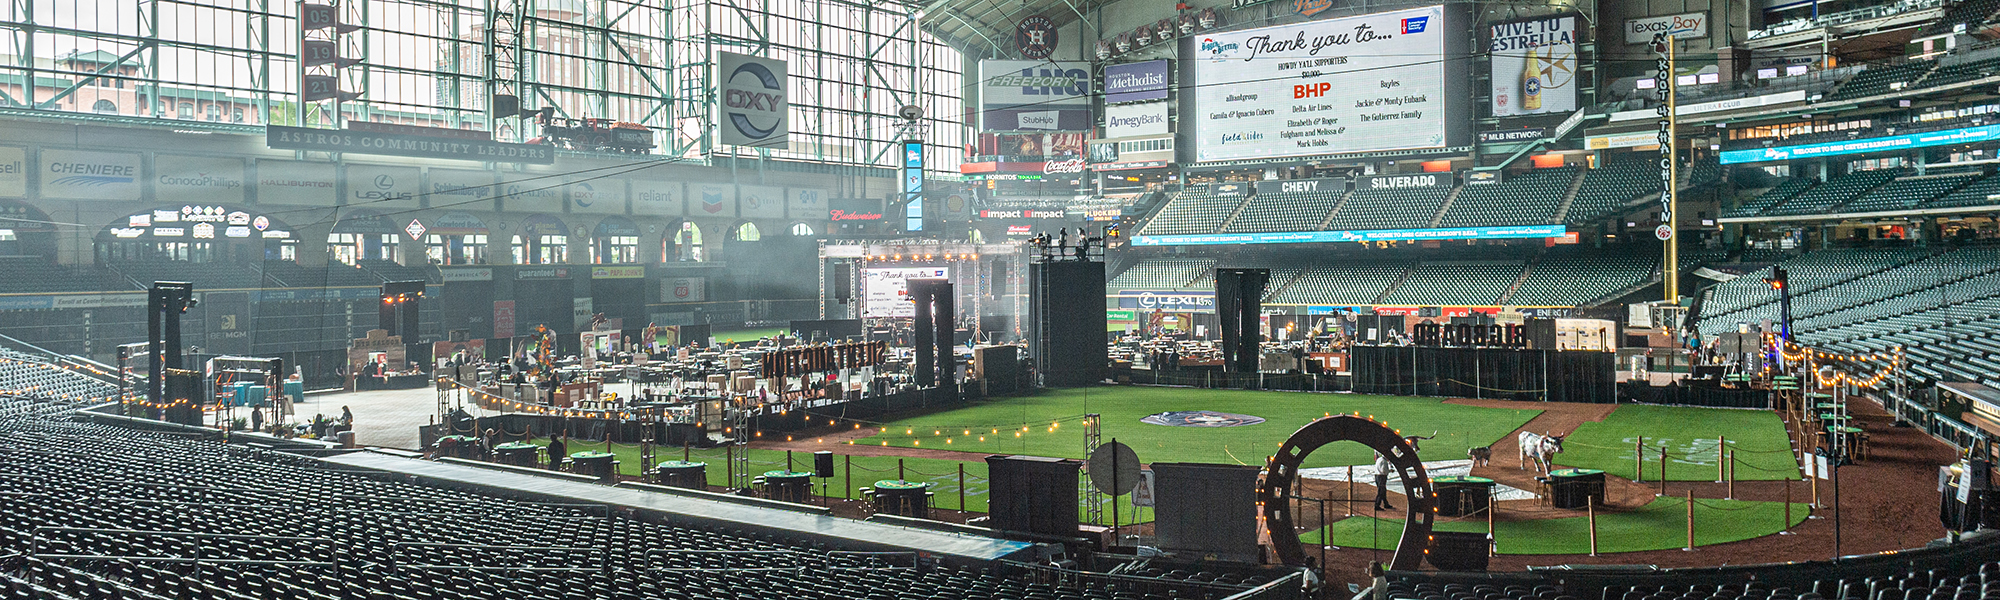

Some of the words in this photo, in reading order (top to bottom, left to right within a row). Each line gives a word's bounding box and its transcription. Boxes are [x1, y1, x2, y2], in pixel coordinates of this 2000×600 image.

[310, 10, 329, 23] 05
[1020, 16, 1053, 30] HOUSTON
[1540, 20, 1560, 33] TU
[1629, 20, 1668, 33] Texas
[1673, 16, 1702, 31] Bay
[1244, 30, 1308, 61] Thank
[1309, 33, 1350, 56] you
[1354, 23, 1393, 43] to...
[1491, 30, 1575, 51] ESTRELLA!
[312, 47, 330, 60] 19
[1022, 46, 1052, 58] ASTROS
[1277, 61, 1297, 70] HOWDY
[1314, 56, 1348, 67] SUPPORTERS
[989, 76, 1075, 87] FREEPORT
[1022, 68, 1088, 96] LNG
[1108, 72, 1163, 88] Methodist
[1380, 79, 1400, 89] Bayles
[311, 81, 329, 94] 21
[1293, 82, 1332, 99] BHP
[725, 88, 782, 112] OXY
[1226, 93, 1258, 102] alliantgroup
[1355, 99, 1374, 108] Jackie
[1375, 98, 1383, 106] &
[1384, 96, 1403, 106] Monty
[1404, 94, 1427, 104] Eubank
[1209, 111, 1228, 120] Camila
[1229, 110, 1236, 118] &
[1236, 110, 1256, 119] Ignacio
[1256, 108, 1275, 116] Cubero
[1292, 105, 1307, 113] Delta
[1308, 104, 1317, 112] Air
[1318, 103, 1333, 111] Lines
[1658, 106, 1669, 117] 4
[1022, 116, 1053, 125] StubHub
[1109, 113, 1164, 129] AmegyBank
[1287, 118, 1313, 127] Elizabeth
[1321, 117, 1338, 126] Roger
[1360, 114, 1371, 122] The
[1371, 112, 1400, 121] Gutierrez
[1400, 110, 1423, 120] Family
[1221, 133, 1242, 145] field
[1280, 131, 1304, 140] Fulgham
[1305, 129, 1316, 137] and
[1317, 127, 1337, 136] Melissa
[1488, 132, 1504, 140] MLB
[1505, 130, 1543, 139] NETWORK
[1659, 121, 1670, 154] THA
[279, 131, 352, 146] ASTROS
[361, 136, 471, 154] COMMUNITY
[478, 144, 546, 159] LEADERS
[1296, 140, 1311, 148] Mark
[1312, 139, 1329, 147] Hobbs
[50, 162, 134, 176] CHENIERE
[1044, 158, 1085, 174] Coca-Cola
[159, 174, 240, 189] ConocoPhillips
[261, 179, 333, 188] HALLIBURTON
[1281, 181, 1319, 192] CHEVY
[1371, 175, 1436, 188] SILVERADO
[355, 190, 412, 202] LEXUS
[434, 183, 490, 198] Schlumberger
[521, 189, 556, 198] CALPINE
[638, 191, 672, 202] reliant
[1660, 159, 1671, 222] CHIKIN
[830, 209, 882, 221] Budweiser
[987, 209, 1020, 219] impact
[1031, 209, 1064, 219] impact
[519, 269, 555, 279] guaranteed
[610, 269, 626, 277] PAPA
[626, 269, 643, 277] JOHN'S
[880, 270, 903, 281] Thank
[675, 287, 688, 295] 66
[1537, 308, 1568, 318] ENERGY
[210, 331, 247, 339] BETMGM
